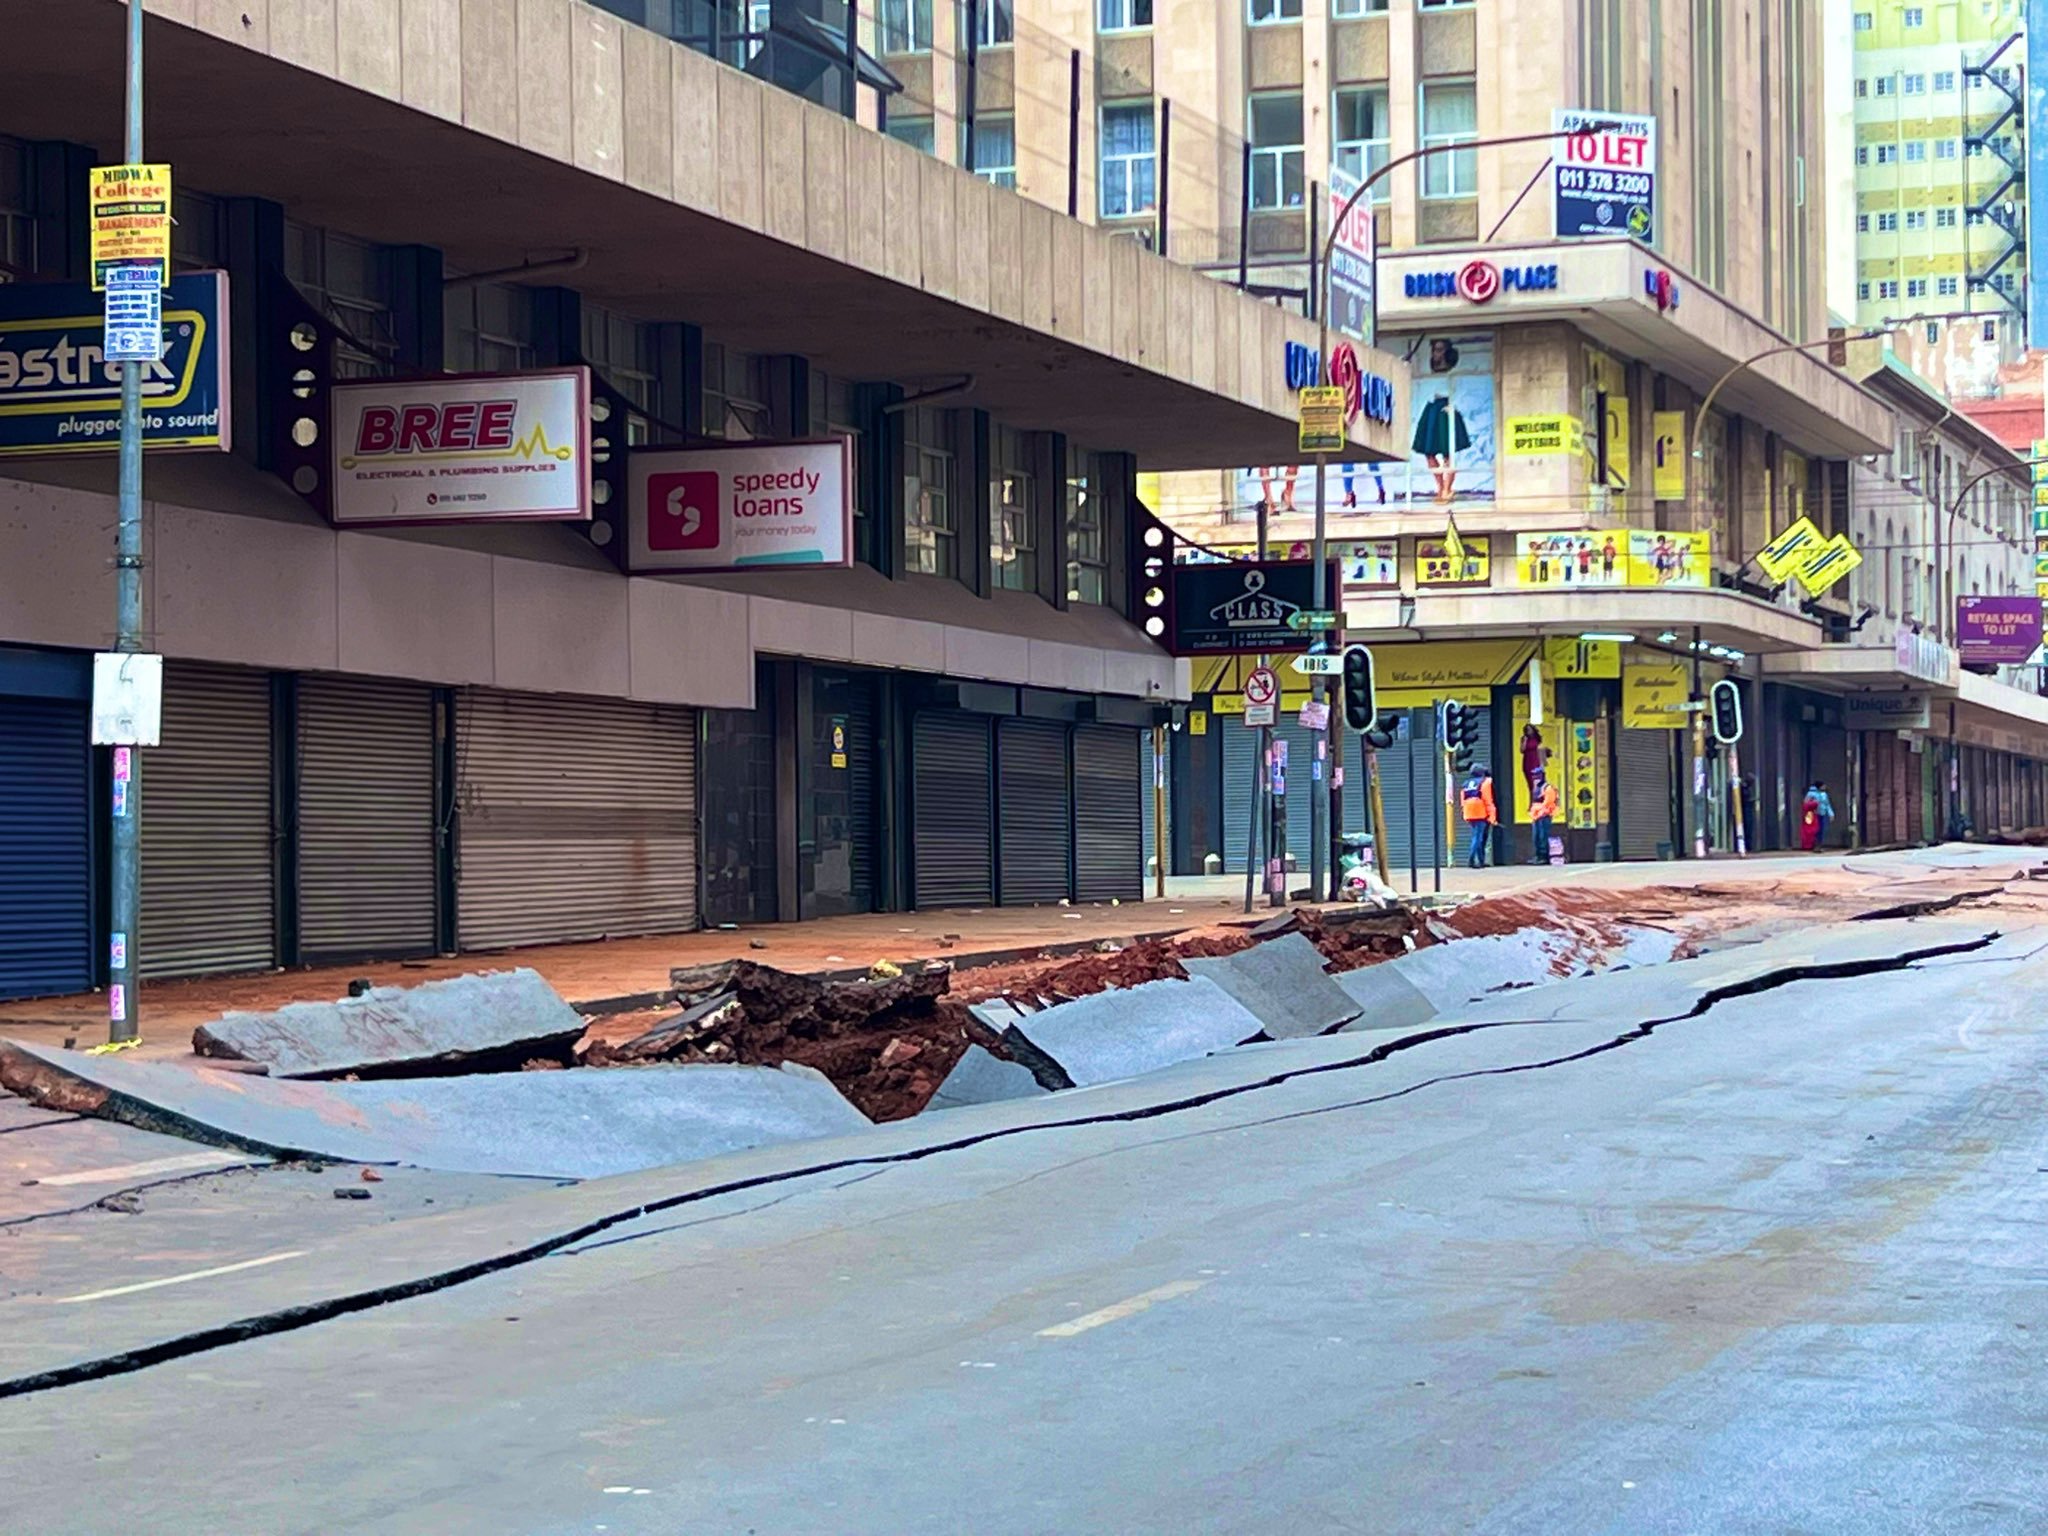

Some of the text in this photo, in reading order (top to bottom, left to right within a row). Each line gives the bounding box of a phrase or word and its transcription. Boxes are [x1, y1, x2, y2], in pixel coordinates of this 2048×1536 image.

[1567, 133, 1647, 168] TO LET
[1559, 168, 1584, 188] 011
[94, 182, 164, 198] College
[1502, 264, 1559, 292] PLACE
[167, 408, 219, 429] sound
[354, 399, 518, 456] BREE
[1514, 421, 1561, 434] WELCOME
[1514, 436, 1561, 449] UPSTAIRS
[355, 463, 557, 481] ELECTRICAL & PLUMBING SUPPLIES
[732, 466, 821, 495] speedy
[732, 494, 804, 518] loans
[734, 523, 818, 538] your money today
[1224, 601, 1284, 620] CLASS
[1967, 612, 2035, 625] RETAIL SPACE
[1983, 625, 2016, 635] TO LET
[1303, 658, 1329, 671] IBIS
[1850, 696, 1903, 711] Unique
